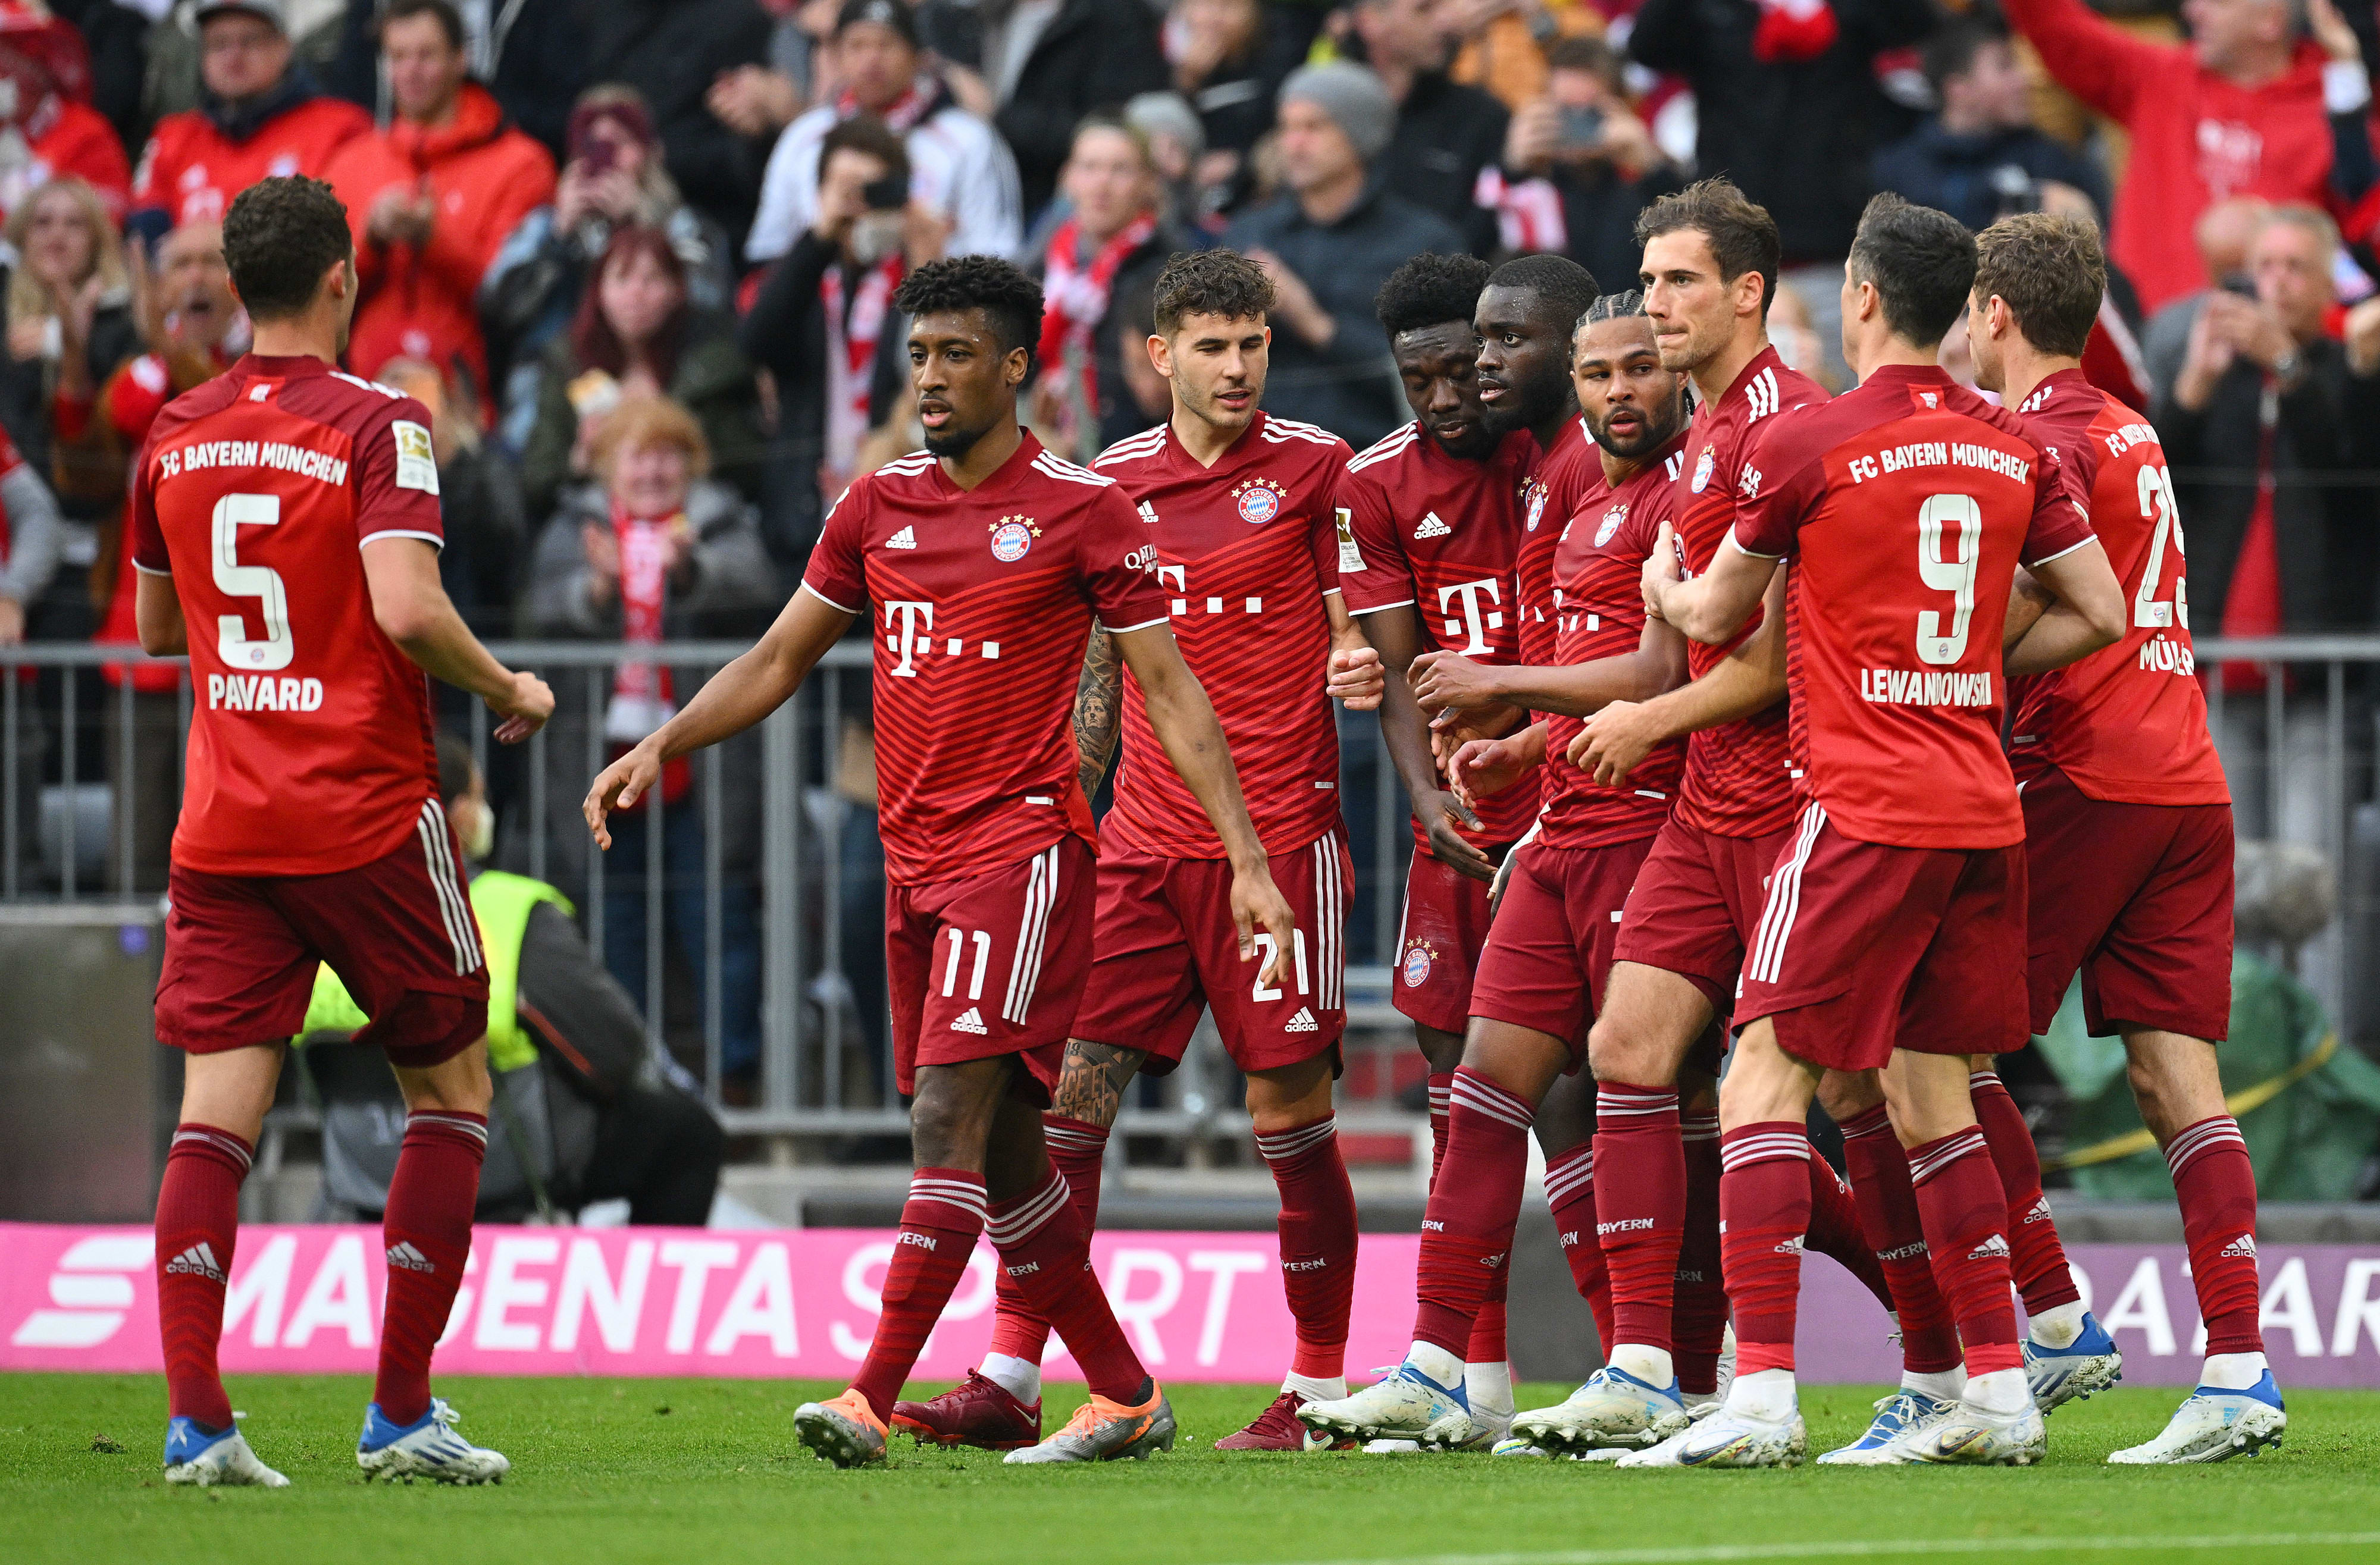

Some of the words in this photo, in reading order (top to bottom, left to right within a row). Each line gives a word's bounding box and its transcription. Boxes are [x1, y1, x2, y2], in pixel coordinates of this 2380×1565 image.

[2105, 433, 2127, 458] FC
[159, 450, 180, 479] FC
[184, 441, 258, 471] BAYERN
[1848, 455, 1878, 484] FC
[1880, 443, 1948, 473] BAYERN
[1952, 443, 2030, 485] MÜNCHEN
[1250, 490, 1275, 504] BAYERN
[1414, 526, 1452, 540] adidas
[885, 539, 917, 550] adidas
[212, 493, 294, 670] 5
[1915, 494, 1983, 665] 9
[208, 673, 322, 712] PAVARD
[942, 928, 991, 1000] 11
[1252, 928, 1309, 1002] 21
[950, 1022, 988, 1035] adidas
[1285, 1022, 1319, 1033] adidas
[1596, 1218, 1654, 1235] BAYERN
[897, 1232, 937, 1252] YERN
[1281, 1257, 1327, 1271] YERN
